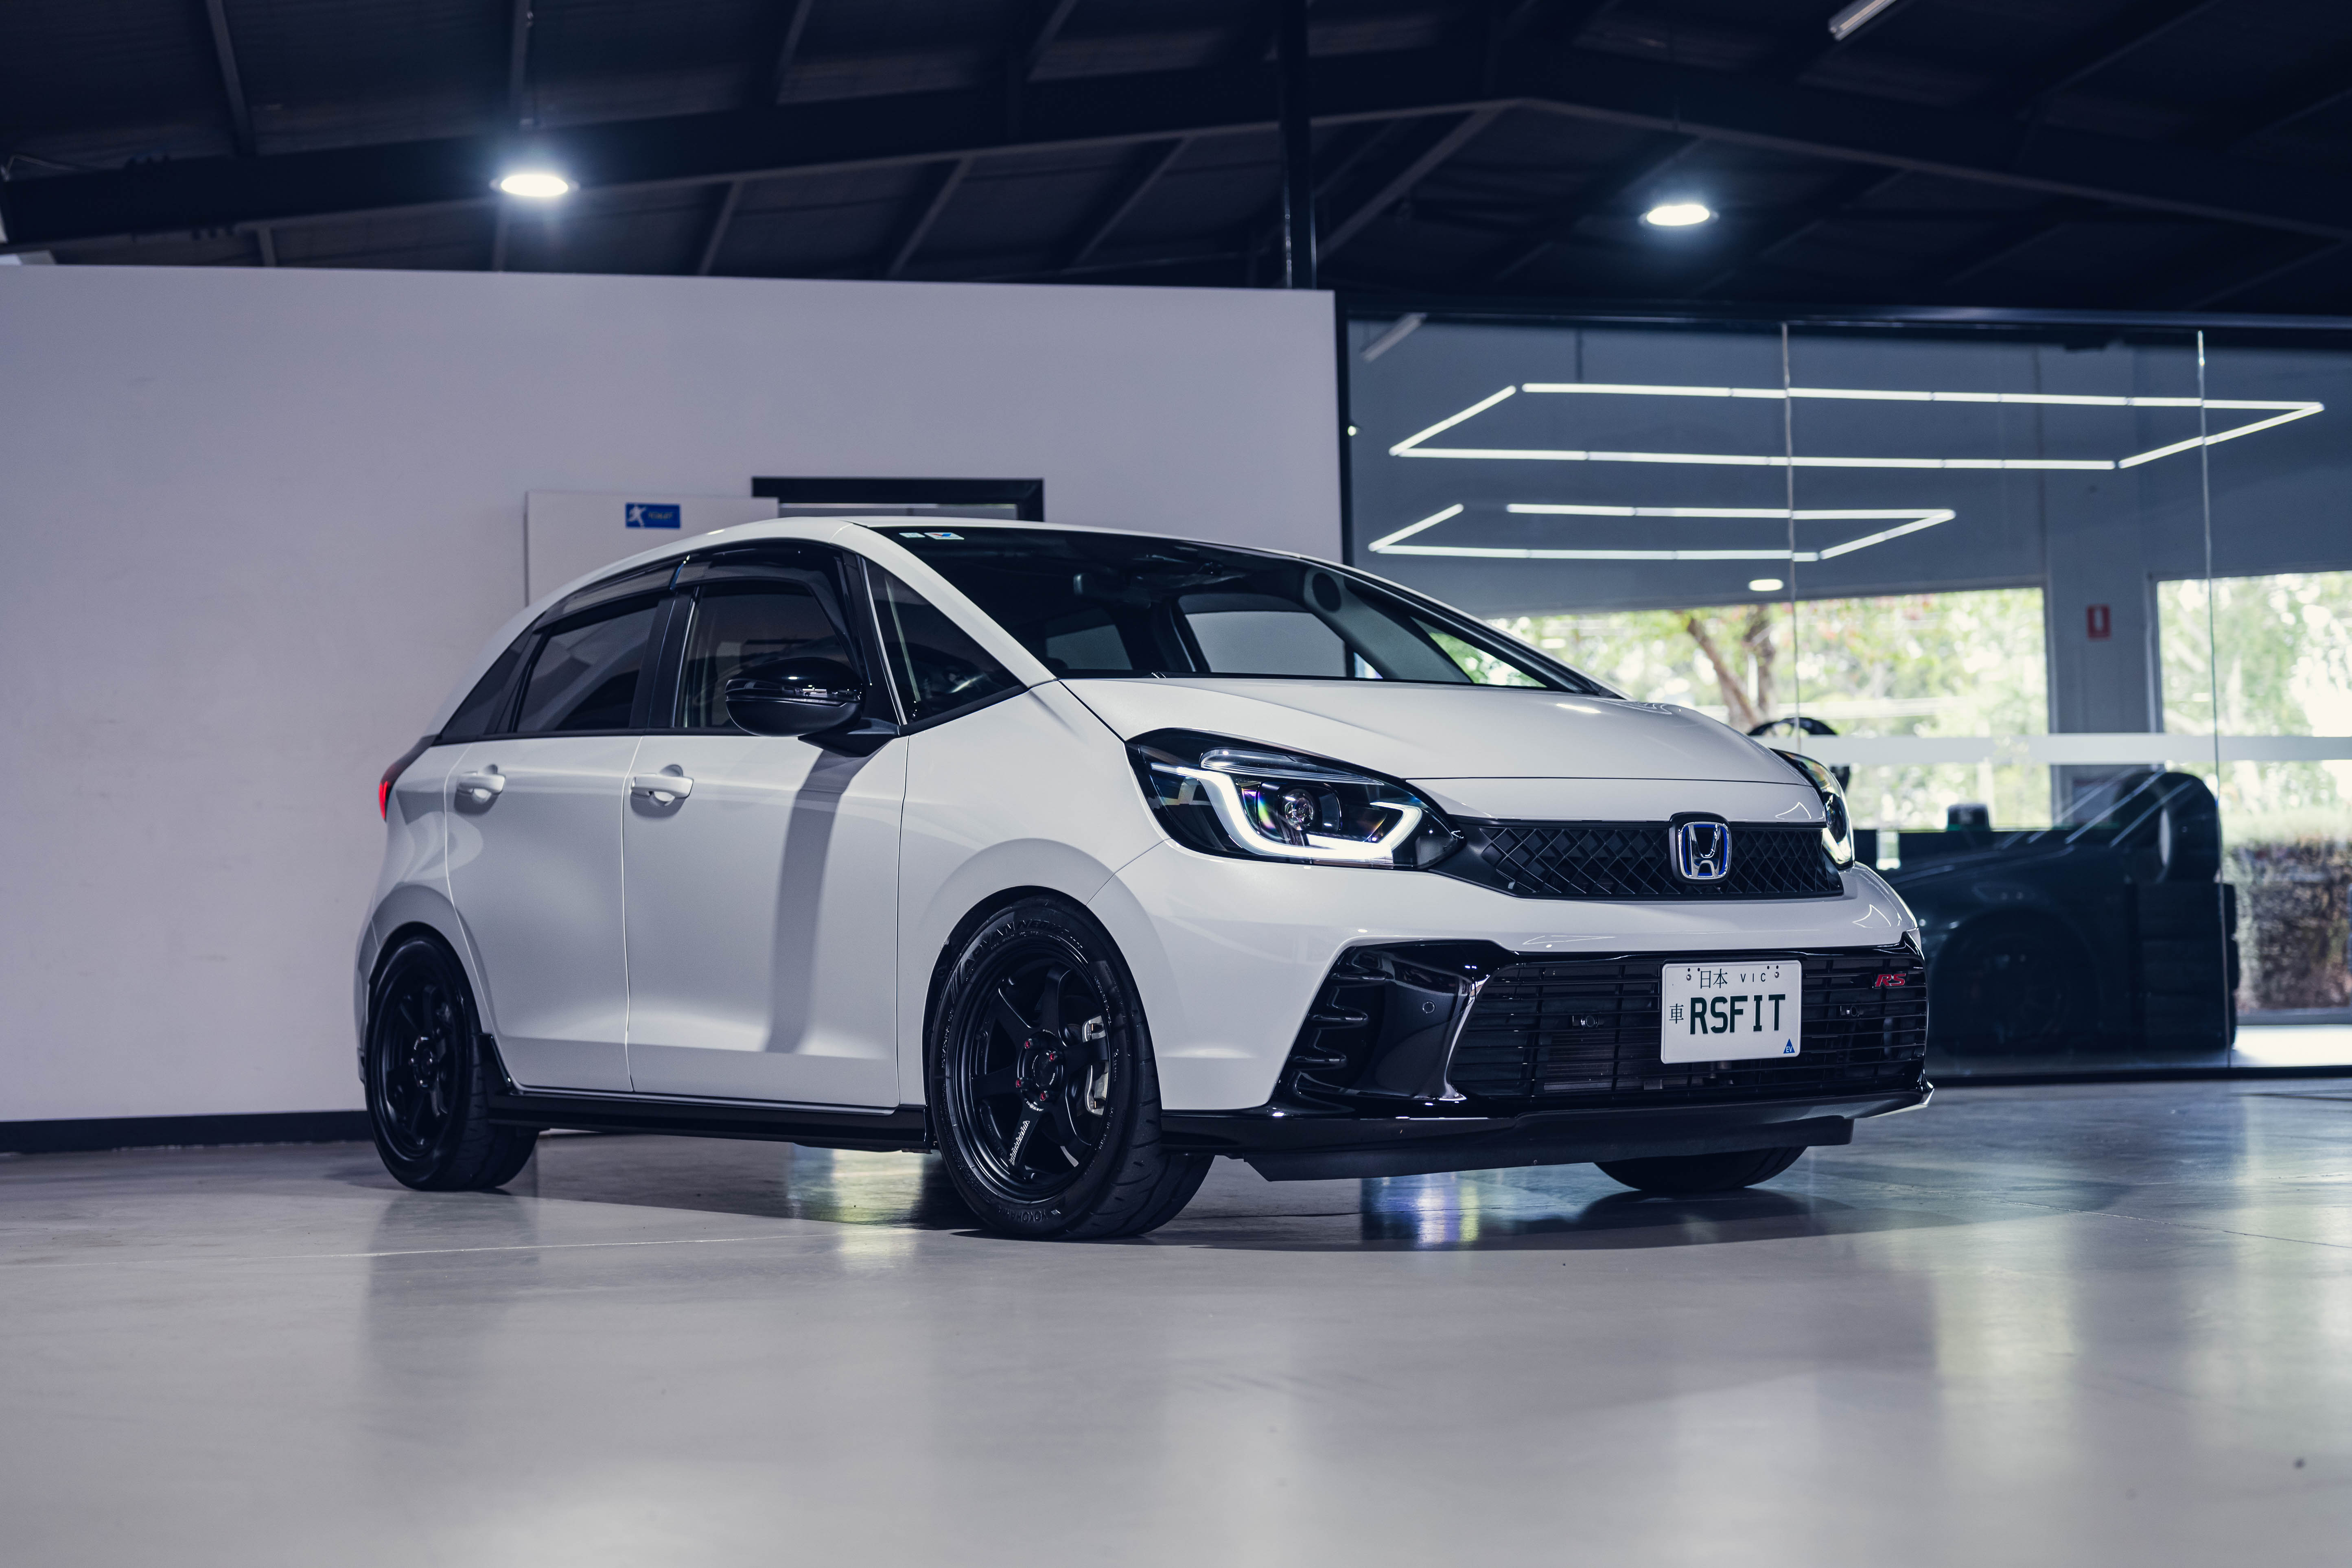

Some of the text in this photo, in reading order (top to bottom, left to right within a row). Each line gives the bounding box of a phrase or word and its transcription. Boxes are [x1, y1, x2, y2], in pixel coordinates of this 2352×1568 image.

[1700, 968, 1766, 989] 日本 VIC
[1875, 973, 1906, 986] RS
[1669, 994, 1785, 1034] 車 RSFIT
